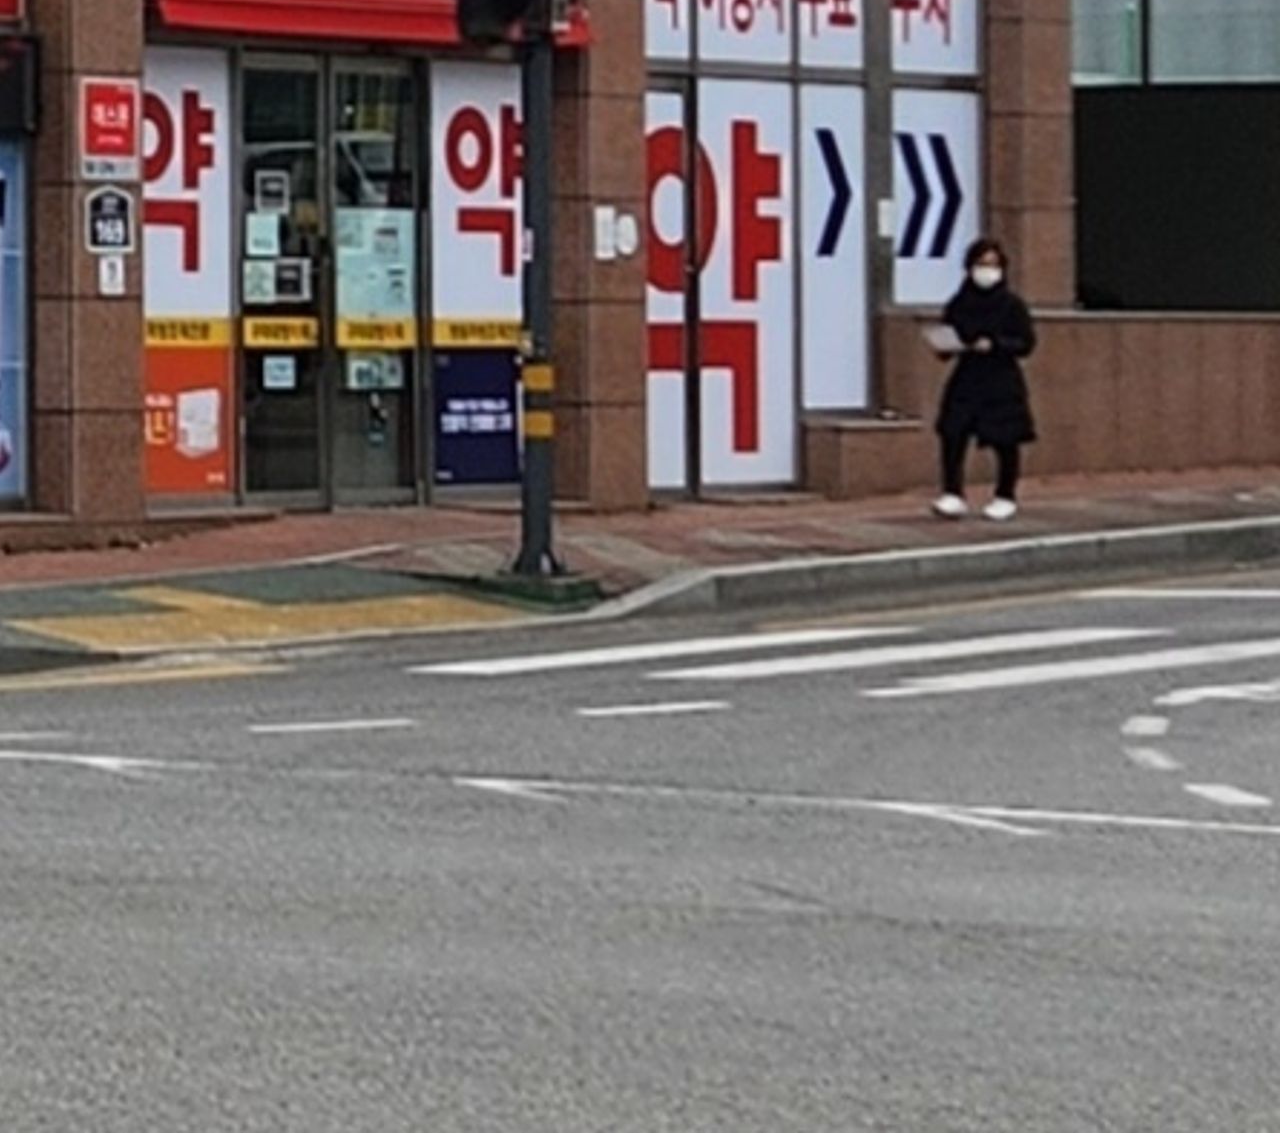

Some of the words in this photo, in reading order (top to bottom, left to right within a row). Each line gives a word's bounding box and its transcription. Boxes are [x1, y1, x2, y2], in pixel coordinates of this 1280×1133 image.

[143, 89, 215, 273] 약
[445, 105, 523, 277] 약
[645, 121, 784, 454] 약
